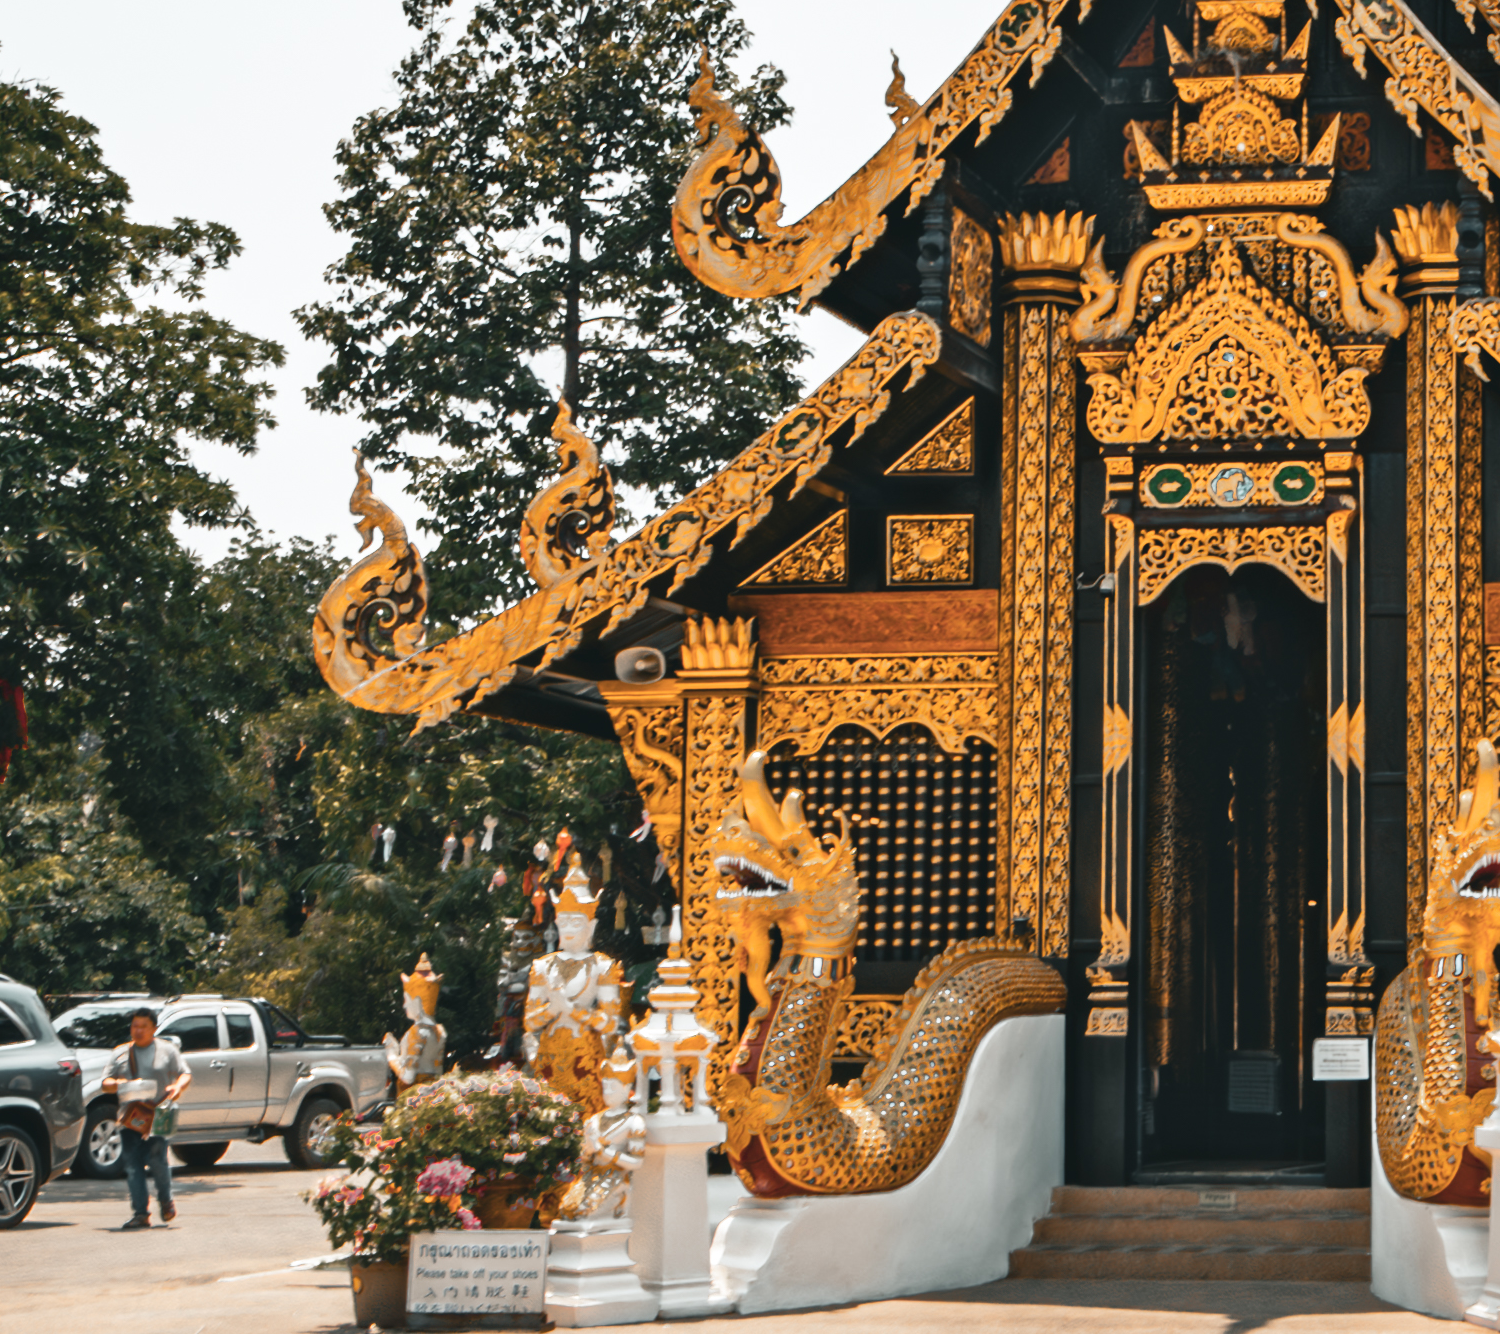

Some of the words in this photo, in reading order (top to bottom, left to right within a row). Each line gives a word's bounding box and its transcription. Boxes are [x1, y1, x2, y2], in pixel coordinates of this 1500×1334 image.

[416, 1267, 446, 1278] Please
[450, 1268, 469, 1278] take
[473, 1268, 485, 1278] off
[488, 1270, 508, 1281] your
[512, 1269, 538, 1279] shoes
